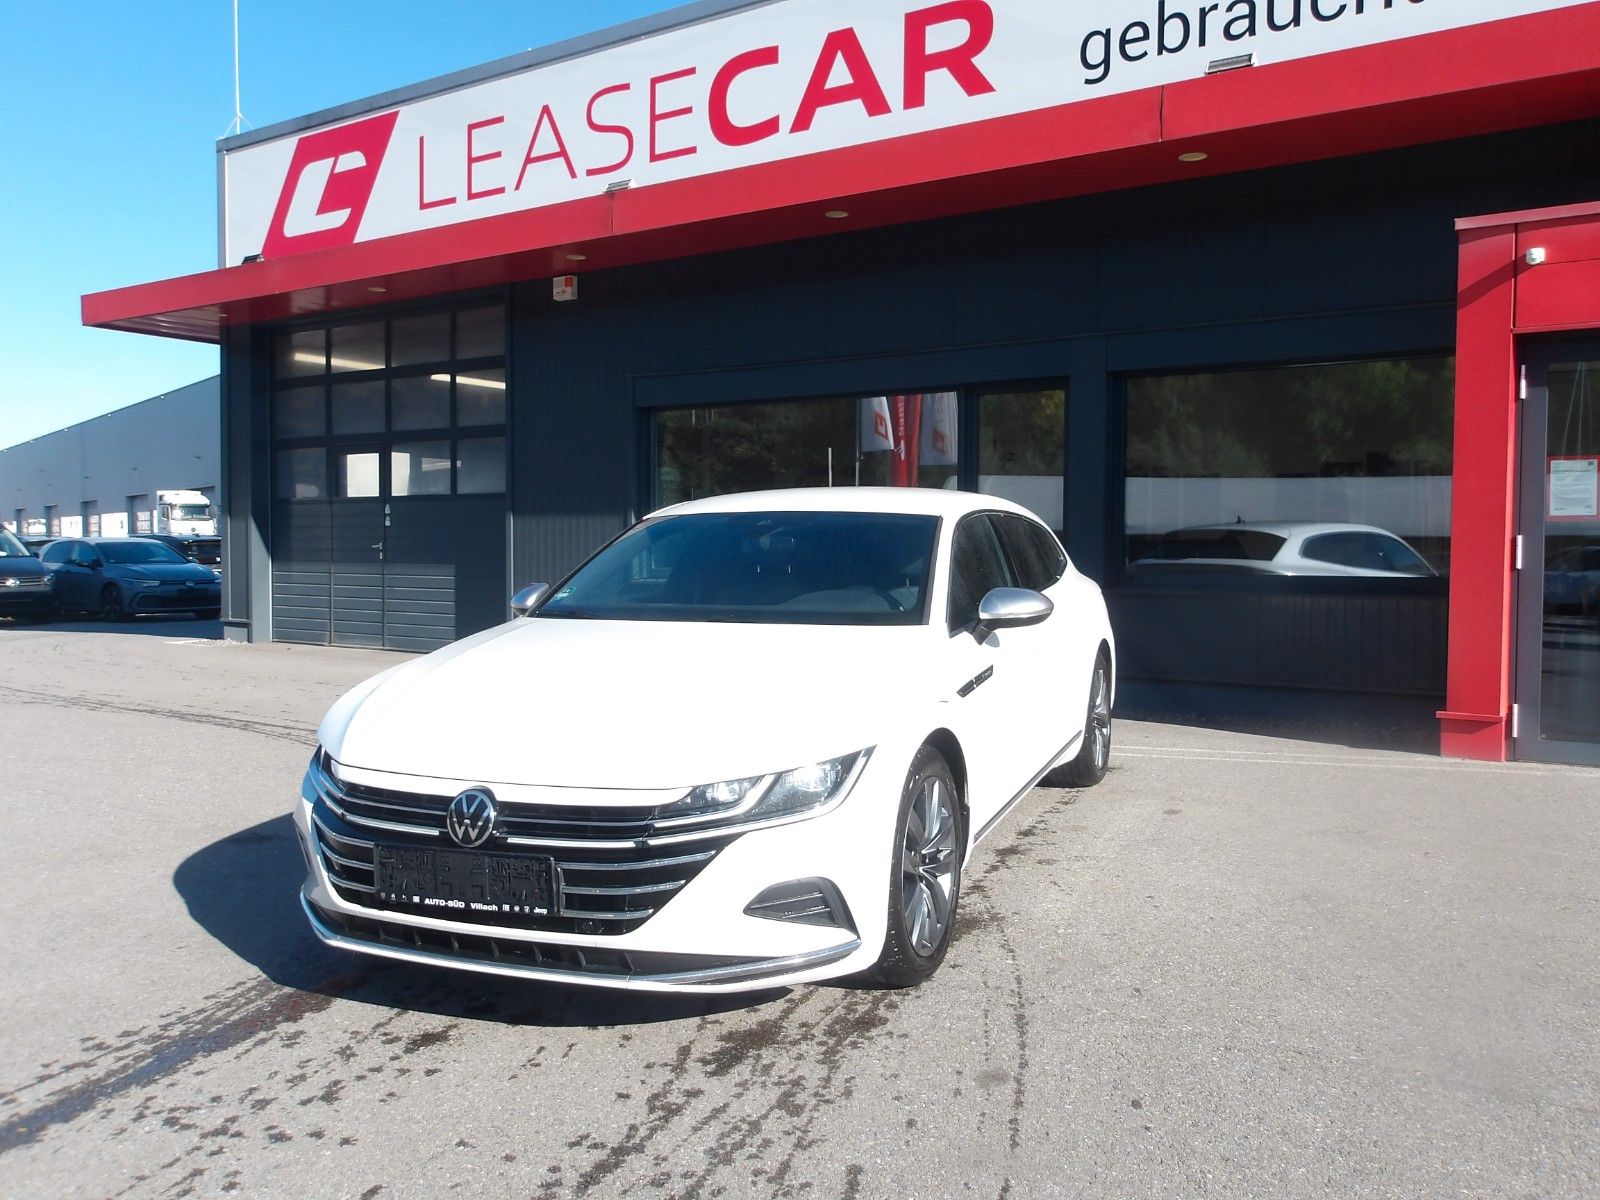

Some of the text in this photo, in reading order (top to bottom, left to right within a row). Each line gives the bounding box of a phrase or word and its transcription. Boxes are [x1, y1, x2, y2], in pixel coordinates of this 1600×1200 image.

[1079, 0, 1425, 85] gebrauc
[419, 0, 996, 211] LEASECAR
[424, 897, 465, 908] AUTO-SÜD
[470, 902, 498, 911] Villach
